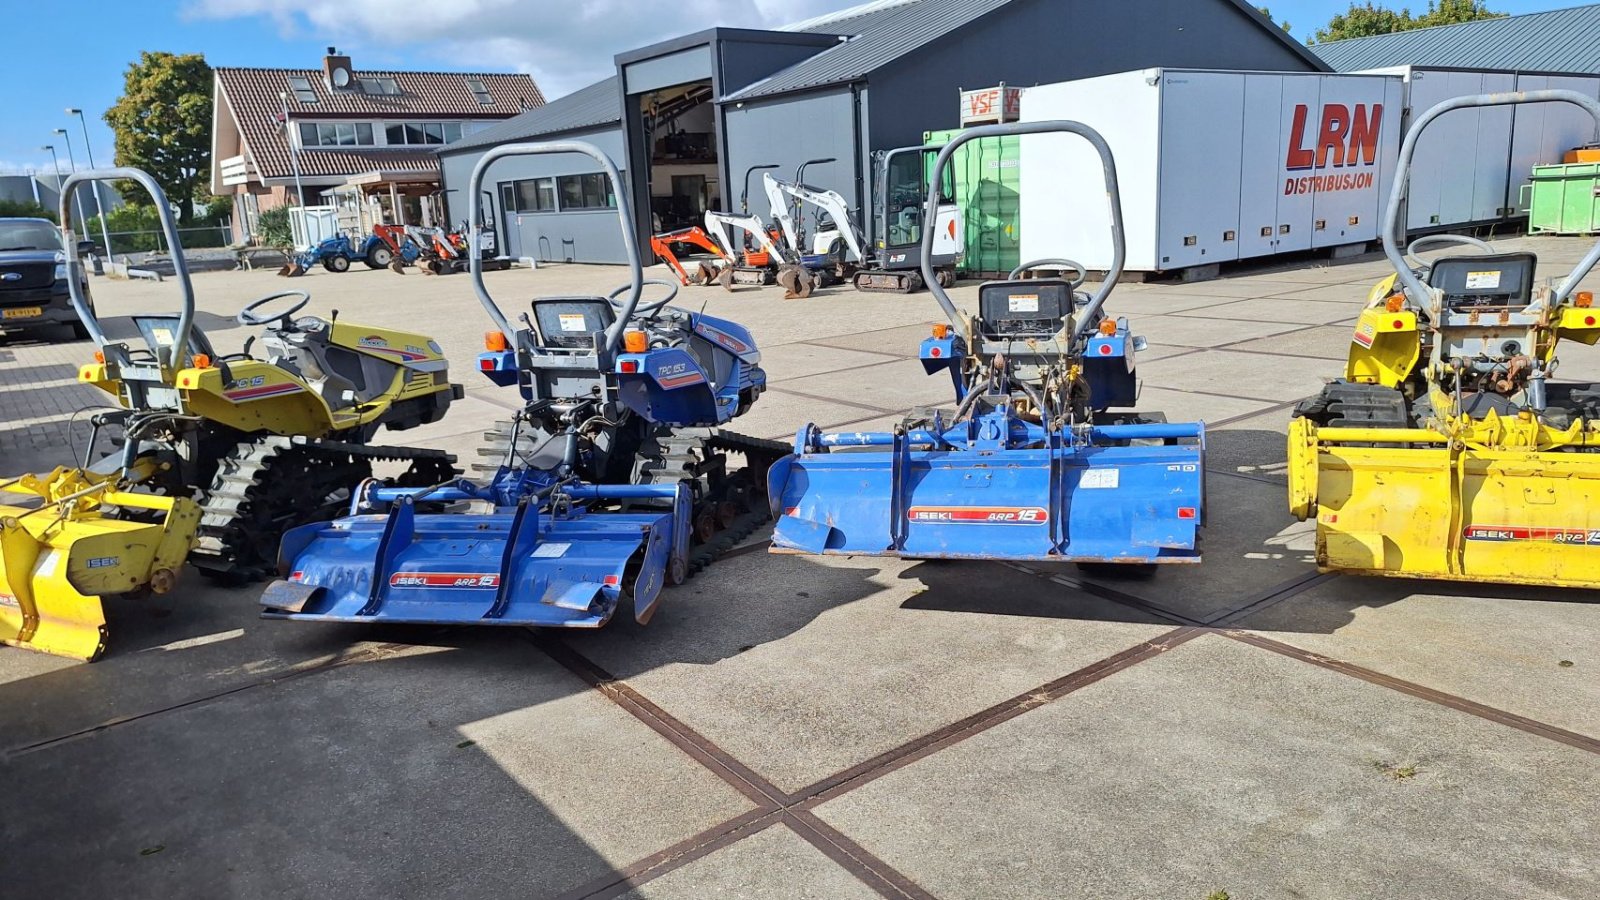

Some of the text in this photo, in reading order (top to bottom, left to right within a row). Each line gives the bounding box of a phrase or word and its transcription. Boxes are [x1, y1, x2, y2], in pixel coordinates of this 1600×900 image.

[970, 90, 999, 116] VSF
[1285, 103, 1383, 171] LRN
[1284, 172, 1373, 196] DISTRIBUSJON
[658, 363, 686, 376] TPC 153
[250, 375, 266, 387] 15
[915, 509, 1037, 521] ISEKI ARP 15
[1471, 530, 1514, 538] ISEKI
[1553, 532, 1584, 542] ARP
[87, 556, 119, 568] ISEKI
[395, 575, 494, 586] ISEKI ARP 15
